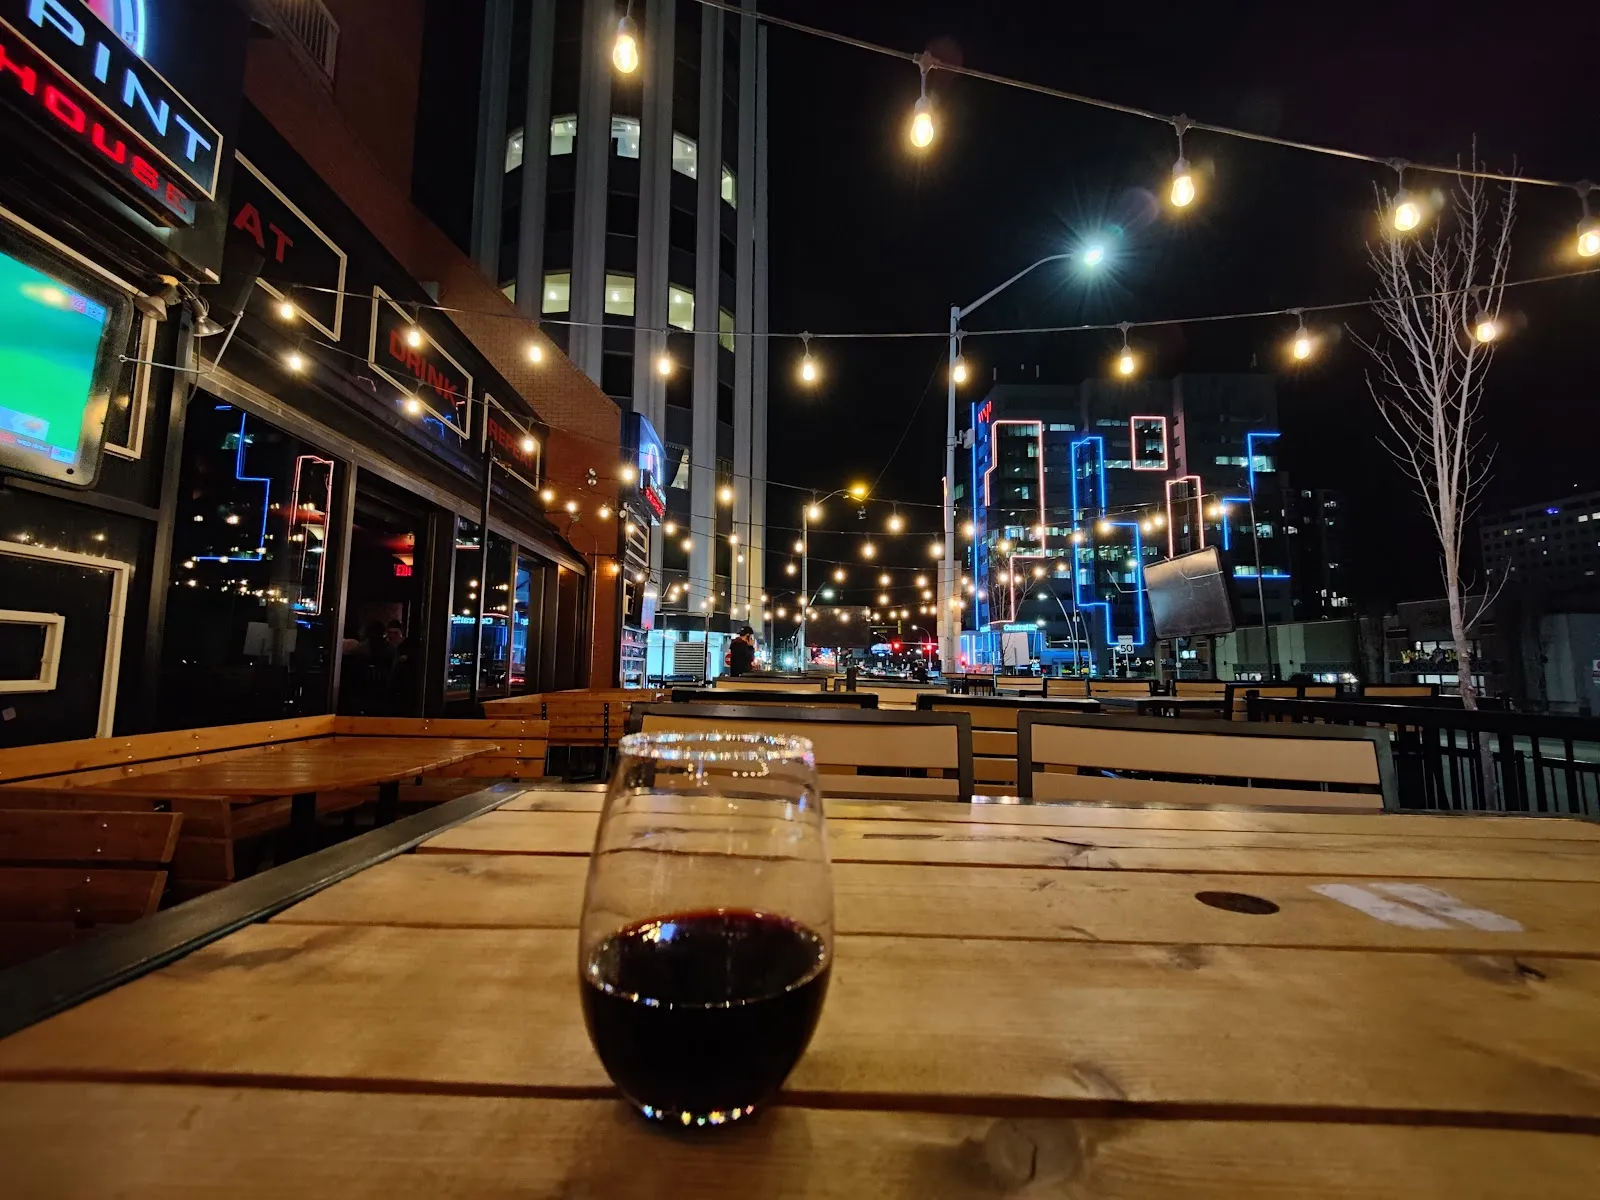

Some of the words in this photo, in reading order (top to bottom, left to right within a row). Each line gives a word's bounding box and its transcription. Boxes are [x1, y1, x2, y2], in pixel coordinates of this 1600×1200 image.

[28, 0, 211, 162] PINT
[0, 43, 188, 215] HOUSE
[233, 203, 293, 263] AT
[390, 330, 458, 408] DRINK
[1120, 644, 1133, 653] 50
